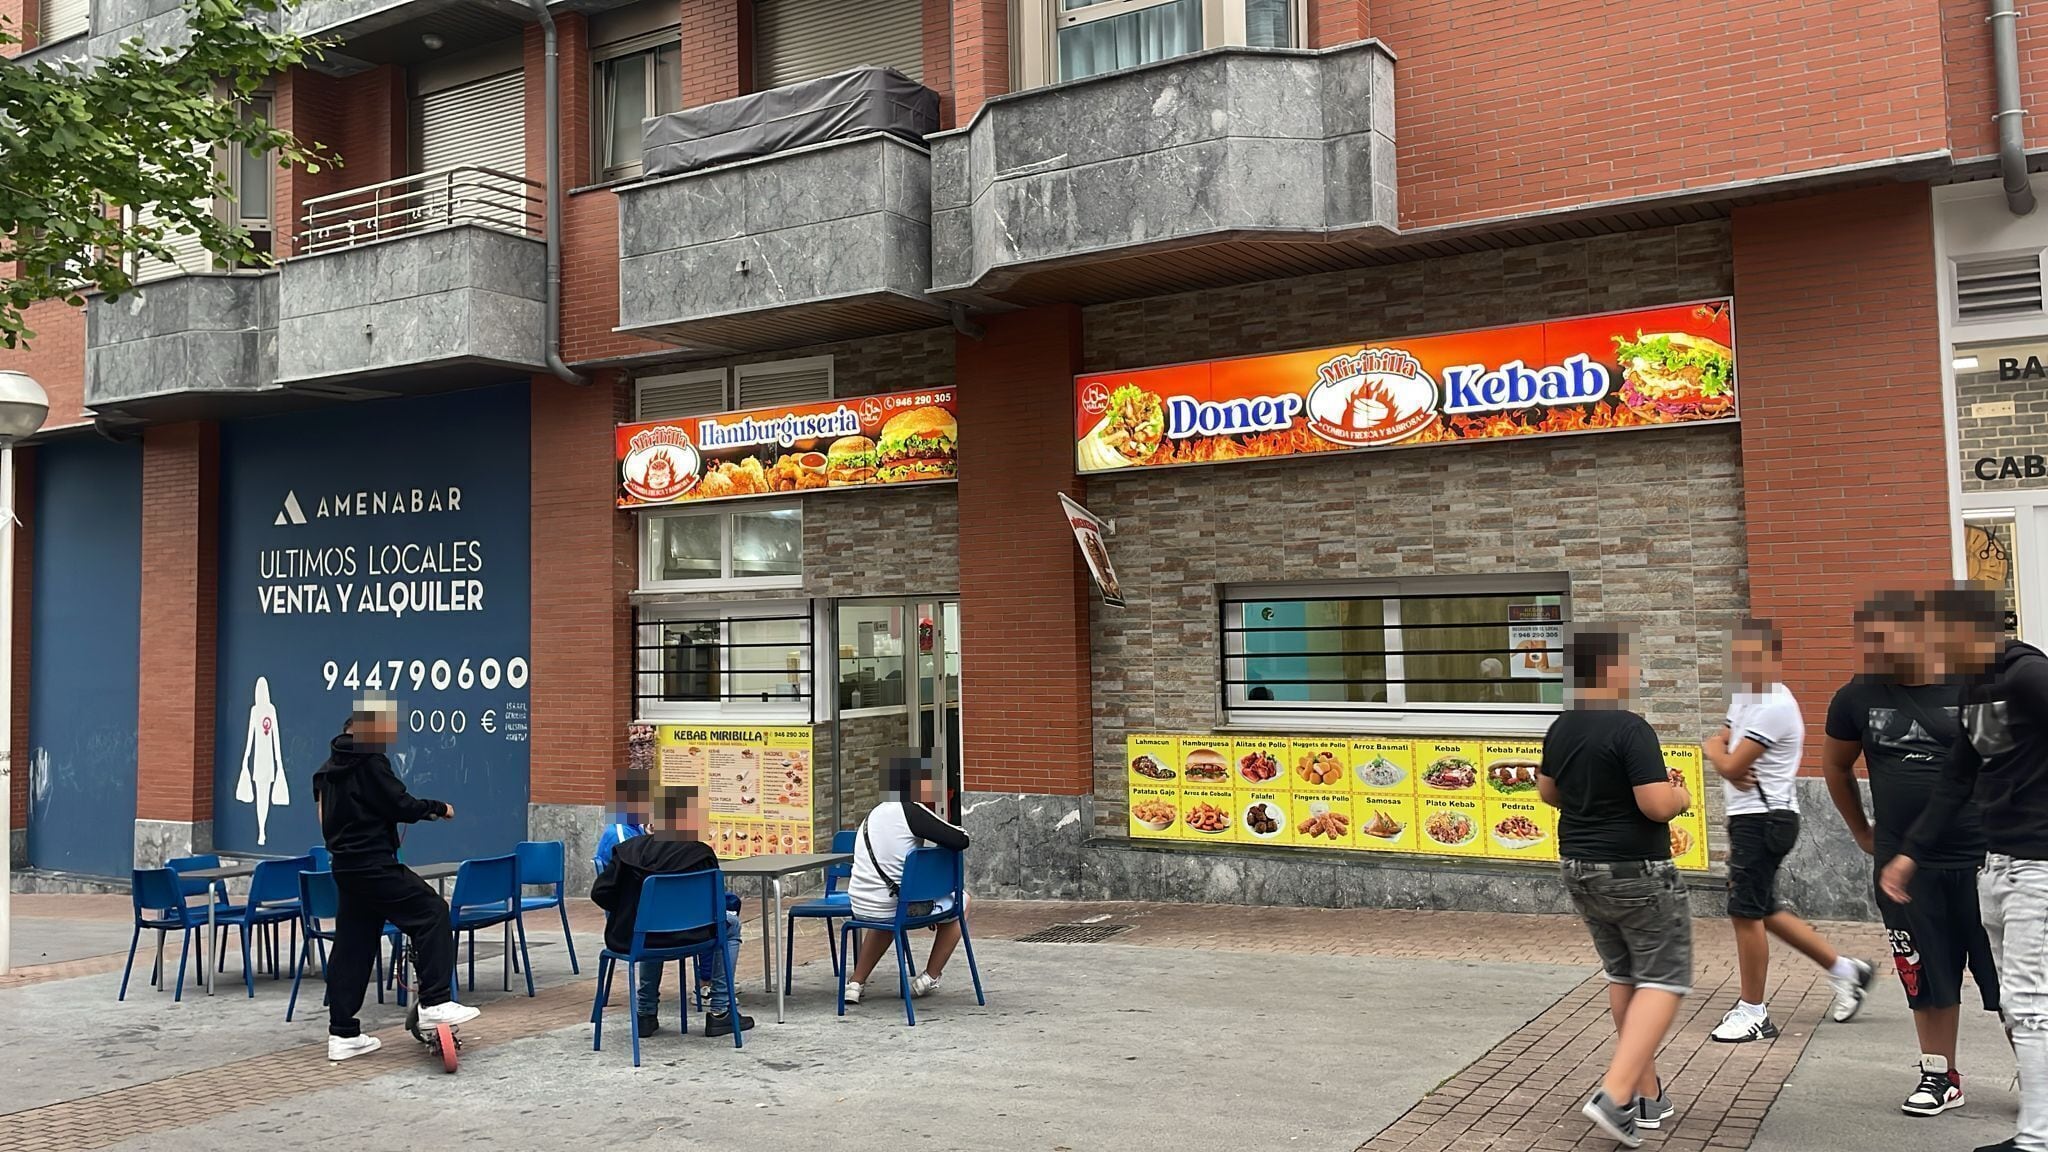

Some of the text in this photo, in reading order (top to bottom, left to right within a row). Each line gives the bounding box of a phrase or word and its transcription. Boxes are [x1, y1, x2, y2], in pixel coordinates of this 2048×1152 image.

[1322, 353, 1416, 386] Miribilla
[1999, 355, 2046, 380] BA
[895, 393, 951, 407] 946 290 305
[1171, 359, 1603, 434] Doner Kebab
[702, 409, 857, 446] Hamburguseria
[1322, 416, 1421, 440] COMIDA FRESCA Y SABROSA
[633, 429, 687, 454] Miribilla
[1974, 455, 2048, 480] CAB
[316, 487, 461, 518] AMENABAR
[260, 540, 482, 579] ULTIMOS LOCALES
[258, 579, 484, 618] VENTA Y ALQUILER
[322, 656, 529, 691] 944790600
[480, 709, 497, 733] €
[674, 730, 762, 741] KEBAB MIRIBILLA
[1376, 743, 1408, 751] Basmati
[1366, 797, 1401, 805] Samosas
[1426, 799, 1447, 807] Plato
[1501, 803, 1535, 811] Pedrata
